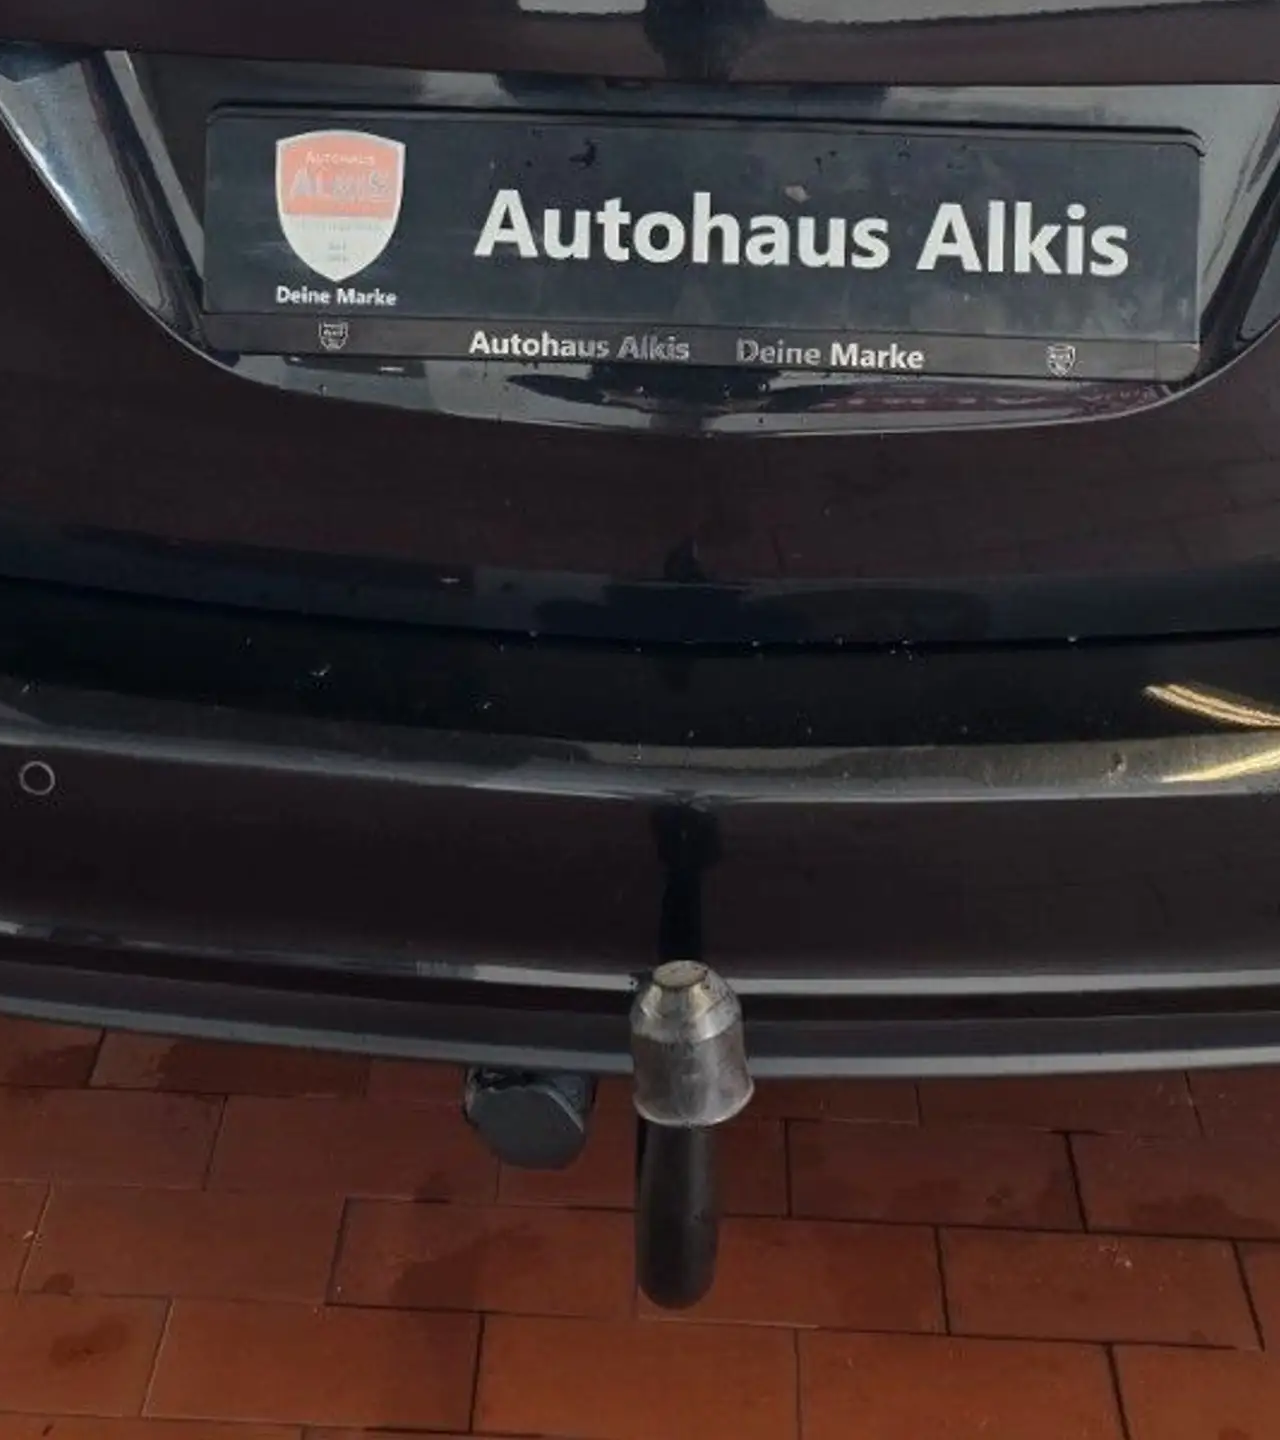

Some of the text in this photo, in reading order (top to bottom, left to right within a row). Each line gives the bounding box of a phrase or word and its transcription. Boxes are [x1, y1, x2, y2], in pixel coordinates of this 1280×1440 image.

[473, 188, 1129, 277] Autohaus Alkis
[275, 285, 398, 307] Deine Marke
[469, 330, 690, 361] Autohaus Alkis
[735, 337, 925, 369] Deine Marke
